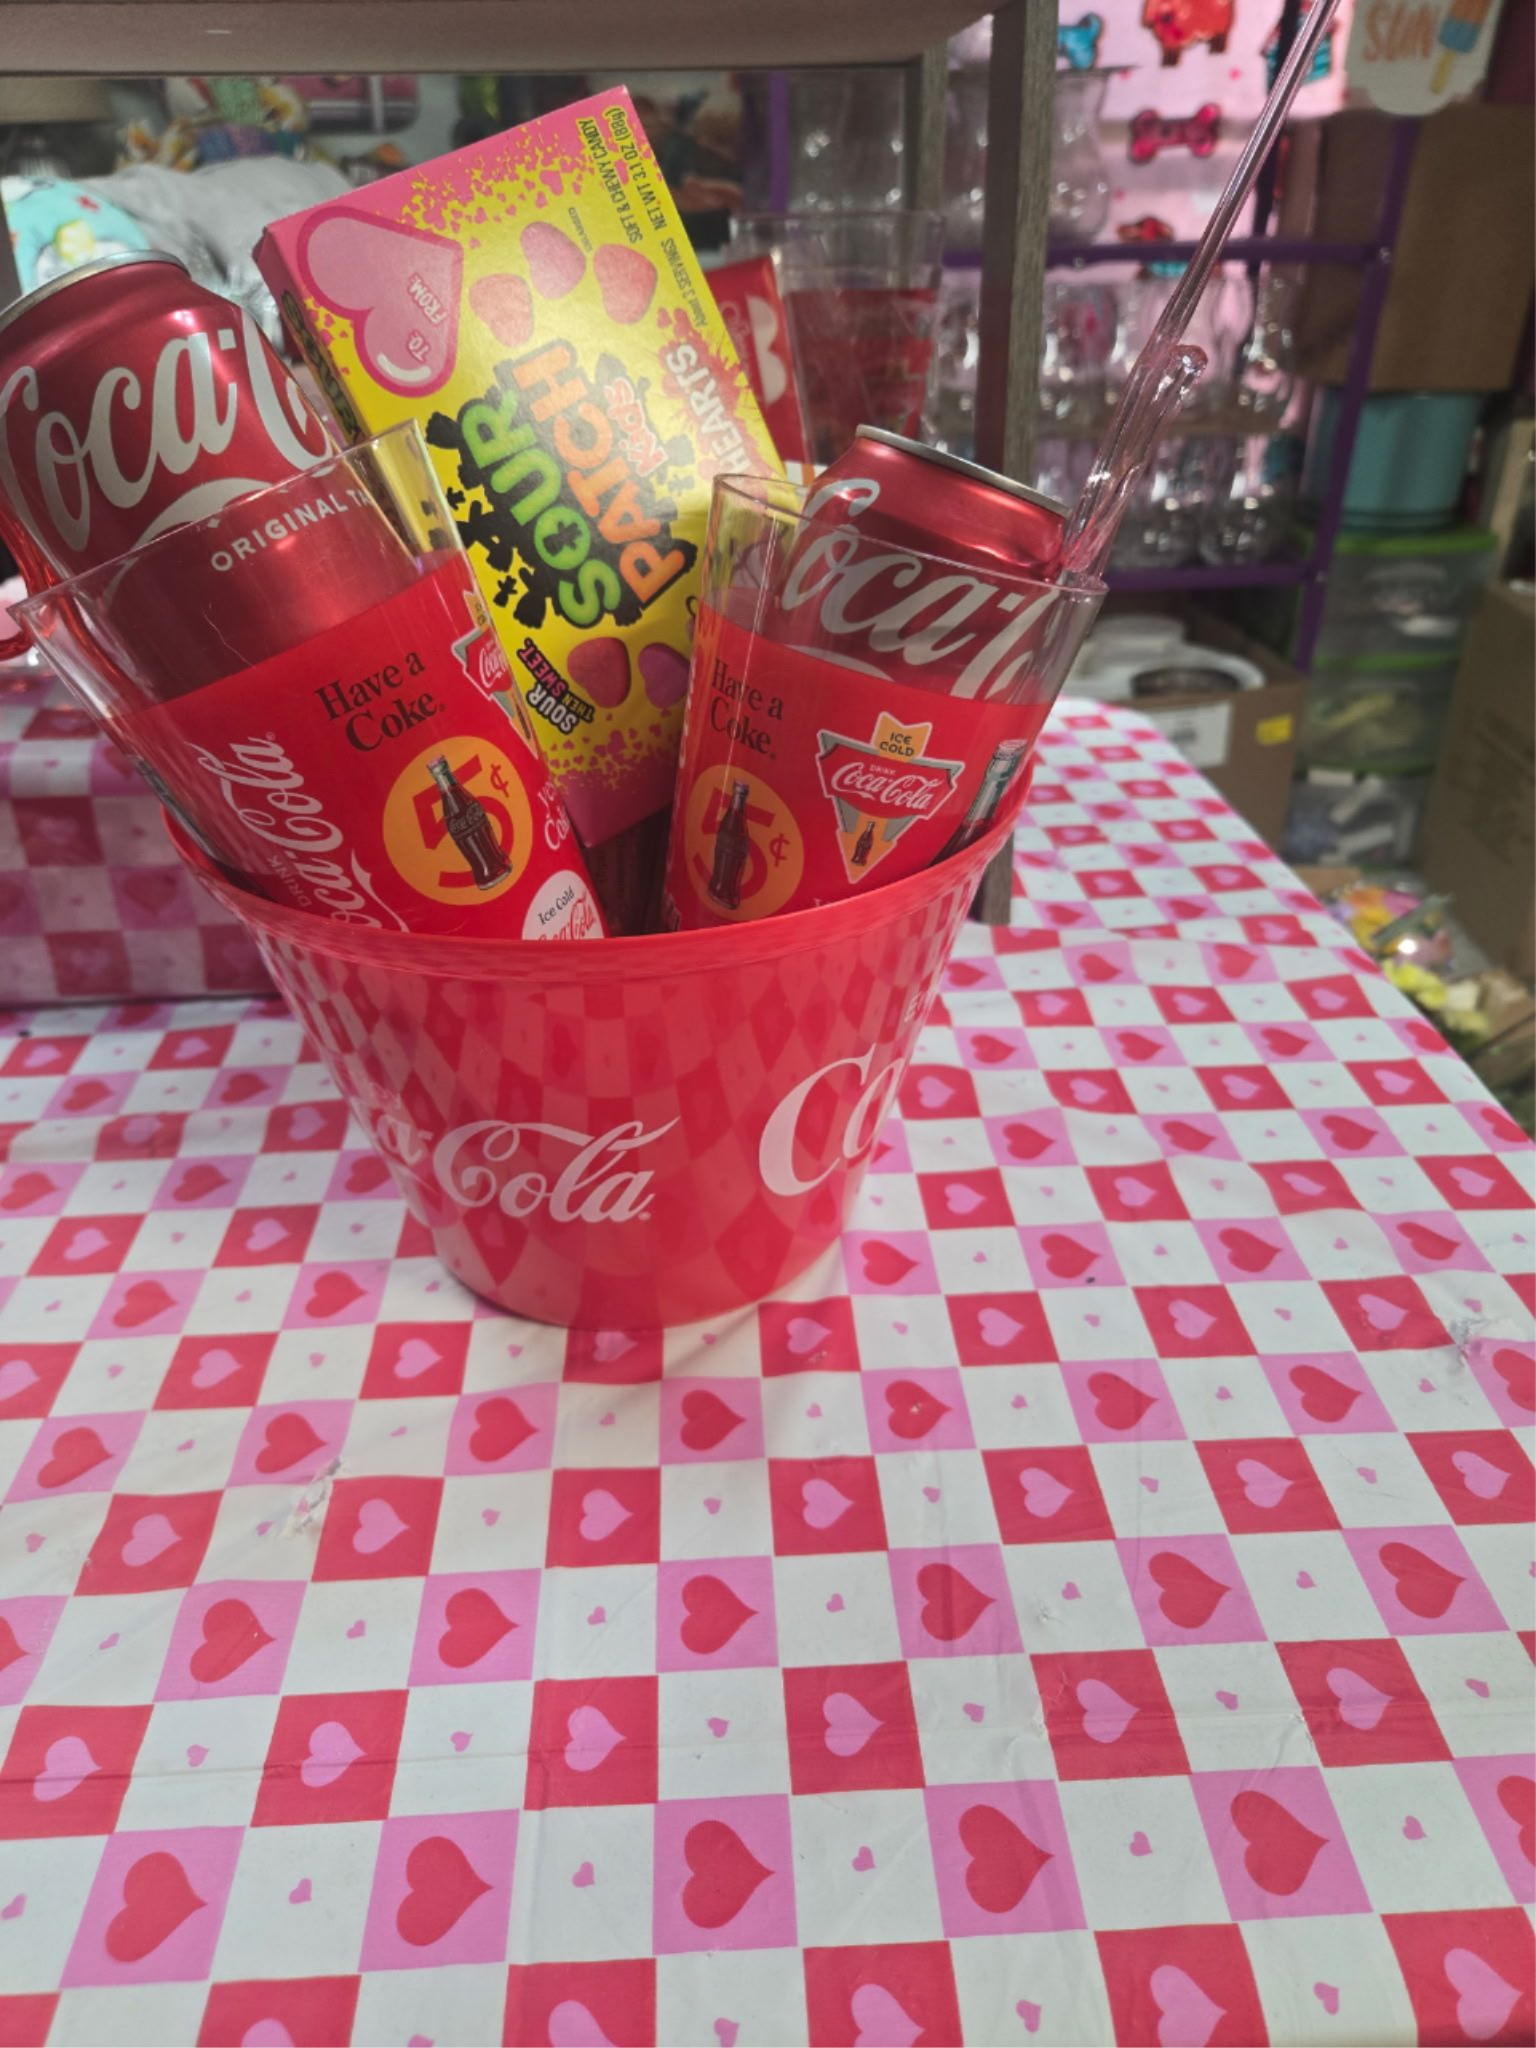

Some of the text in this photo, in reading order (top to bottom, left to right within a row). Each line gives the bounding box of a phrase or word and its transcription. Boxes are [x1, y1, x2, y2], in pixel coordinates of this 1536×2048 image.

[578, 119, 608, 159] CANDY
[597, 160, 626, 204] CHEWY
[606, 108, 667, 231] NET WT 3.1 OZ (88g)
[620, 211, 644, 244] SOFT
[660, 238, 692, 289] SERVINGS
[408, 275, 448, 324] FROM:
[408, 331, 430, 362] TO:
[604, 377, 668, 477] Kids
[667, 344, 752, 474] HEARTS
[512, 346, 685, 604] PATCH
[211, 493, 348, 572] ORIGINAL
[462, 390, 622, 626] SOUR
[314, 650, 426, 723] Have a
[519, 641, 594, 720] THEN SWEET.
[711, 658, 783, 720] Have a
[528, 684, 578, 732] SOUR
[879, 742, 915, 757] COLD
[889, 732, 913, 745] ICE
[831, 762, 943, 810] Coca-Cola
[268, 854, 312, 907] DRINK
[538, 885, 575, 926] Ice Cold
